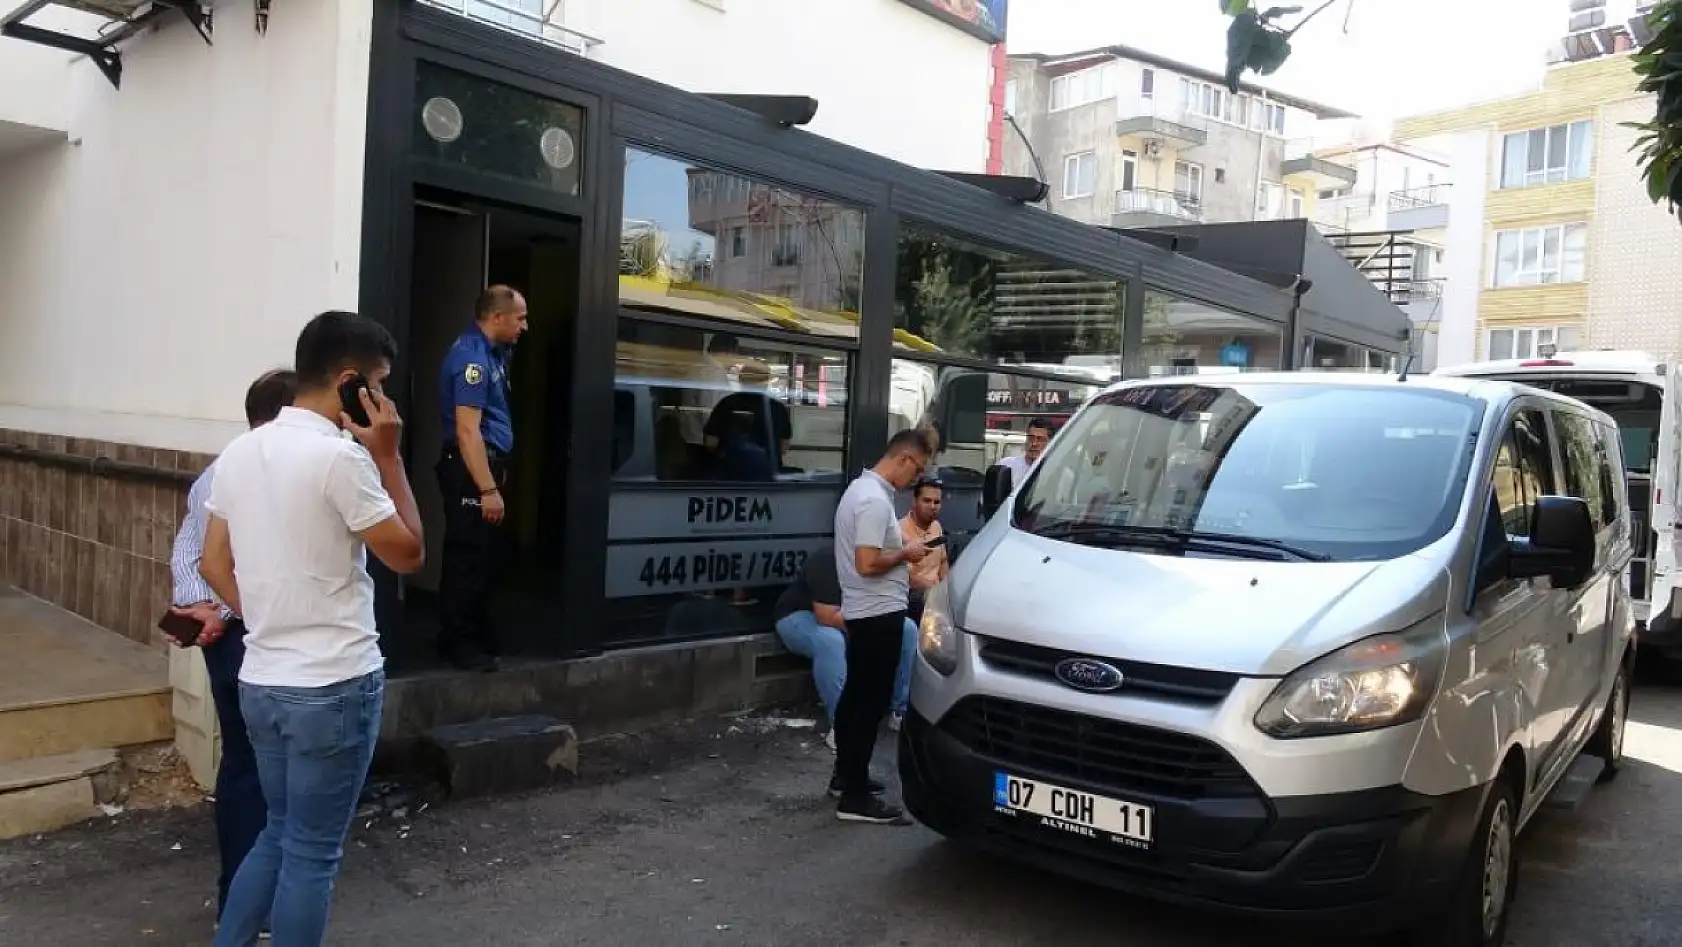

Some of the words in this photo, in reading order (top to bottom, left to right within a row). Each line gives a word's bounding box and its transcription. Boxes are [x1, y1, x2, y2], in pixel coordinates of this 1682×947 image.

[462, 497, 482, 506] POL
[639, 557, 687, 587] 444
[1009, 780, 1034, 807] 07
[1051, 789, 1094, 824] CDH
[1120, 805, 1146, 835] 11
